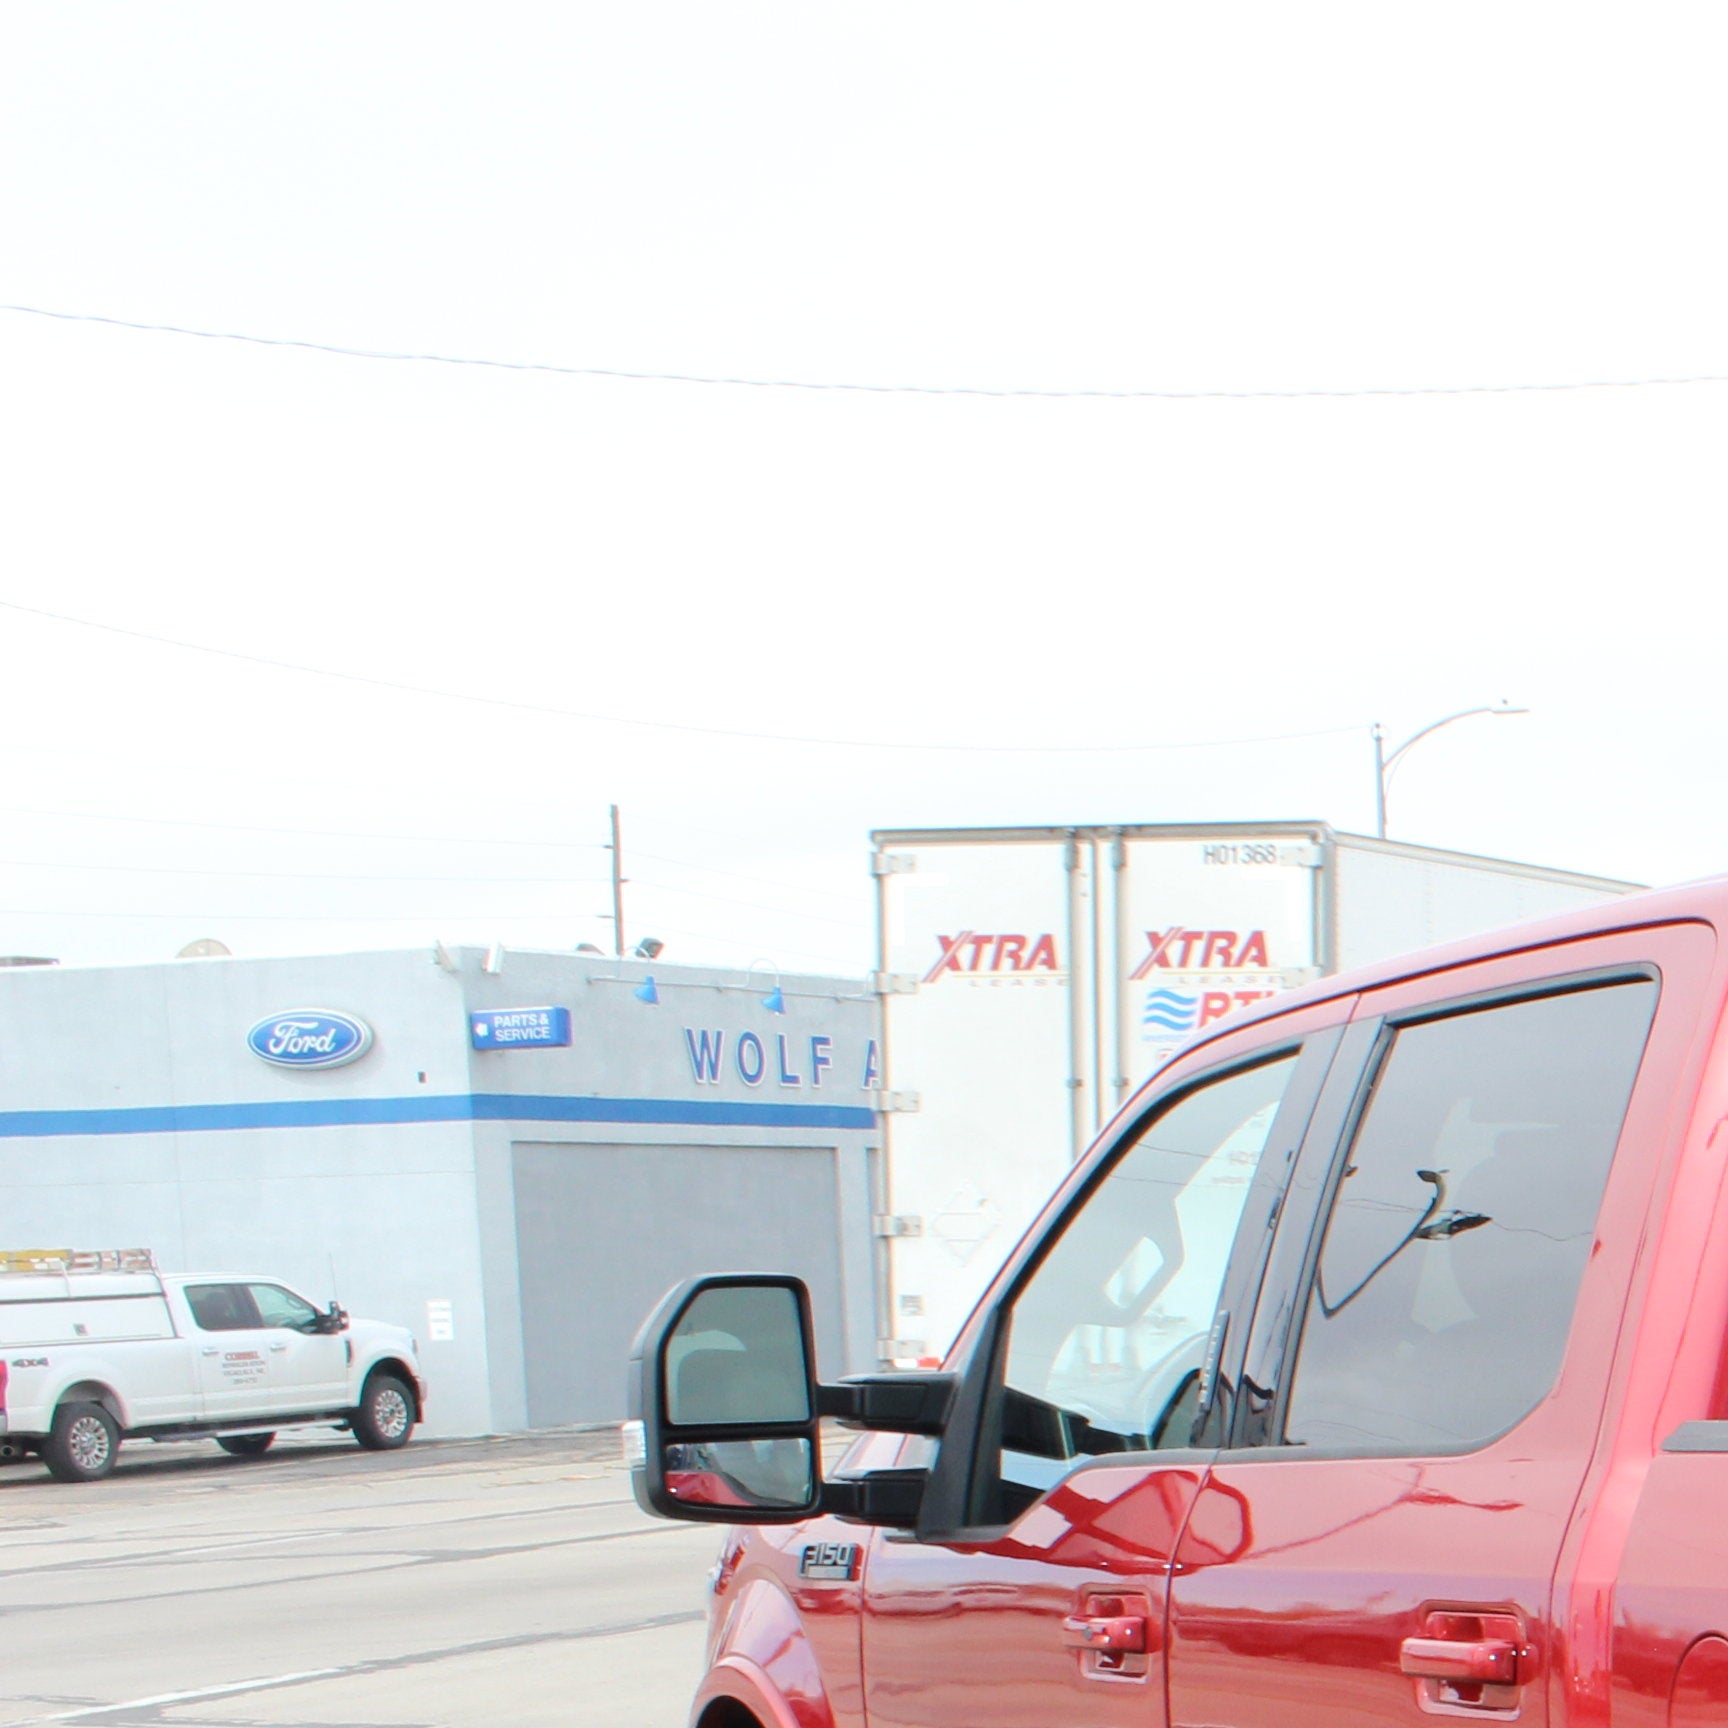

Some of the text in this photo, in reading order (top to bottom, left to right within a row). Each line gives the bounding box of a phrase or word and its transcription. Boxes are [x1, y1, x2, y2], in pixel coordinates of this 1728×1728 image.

[921, 929, 1058, 984] XTRA
[1127, 926, 1269, 981] XTRA
[267, 1021, 338, 1055] Ford
[493, 1014, 550, 1028] PARTS &
[494, 1027, 551, 1042] SERVICE
[684, 1026, 834, 1089] WOLF
